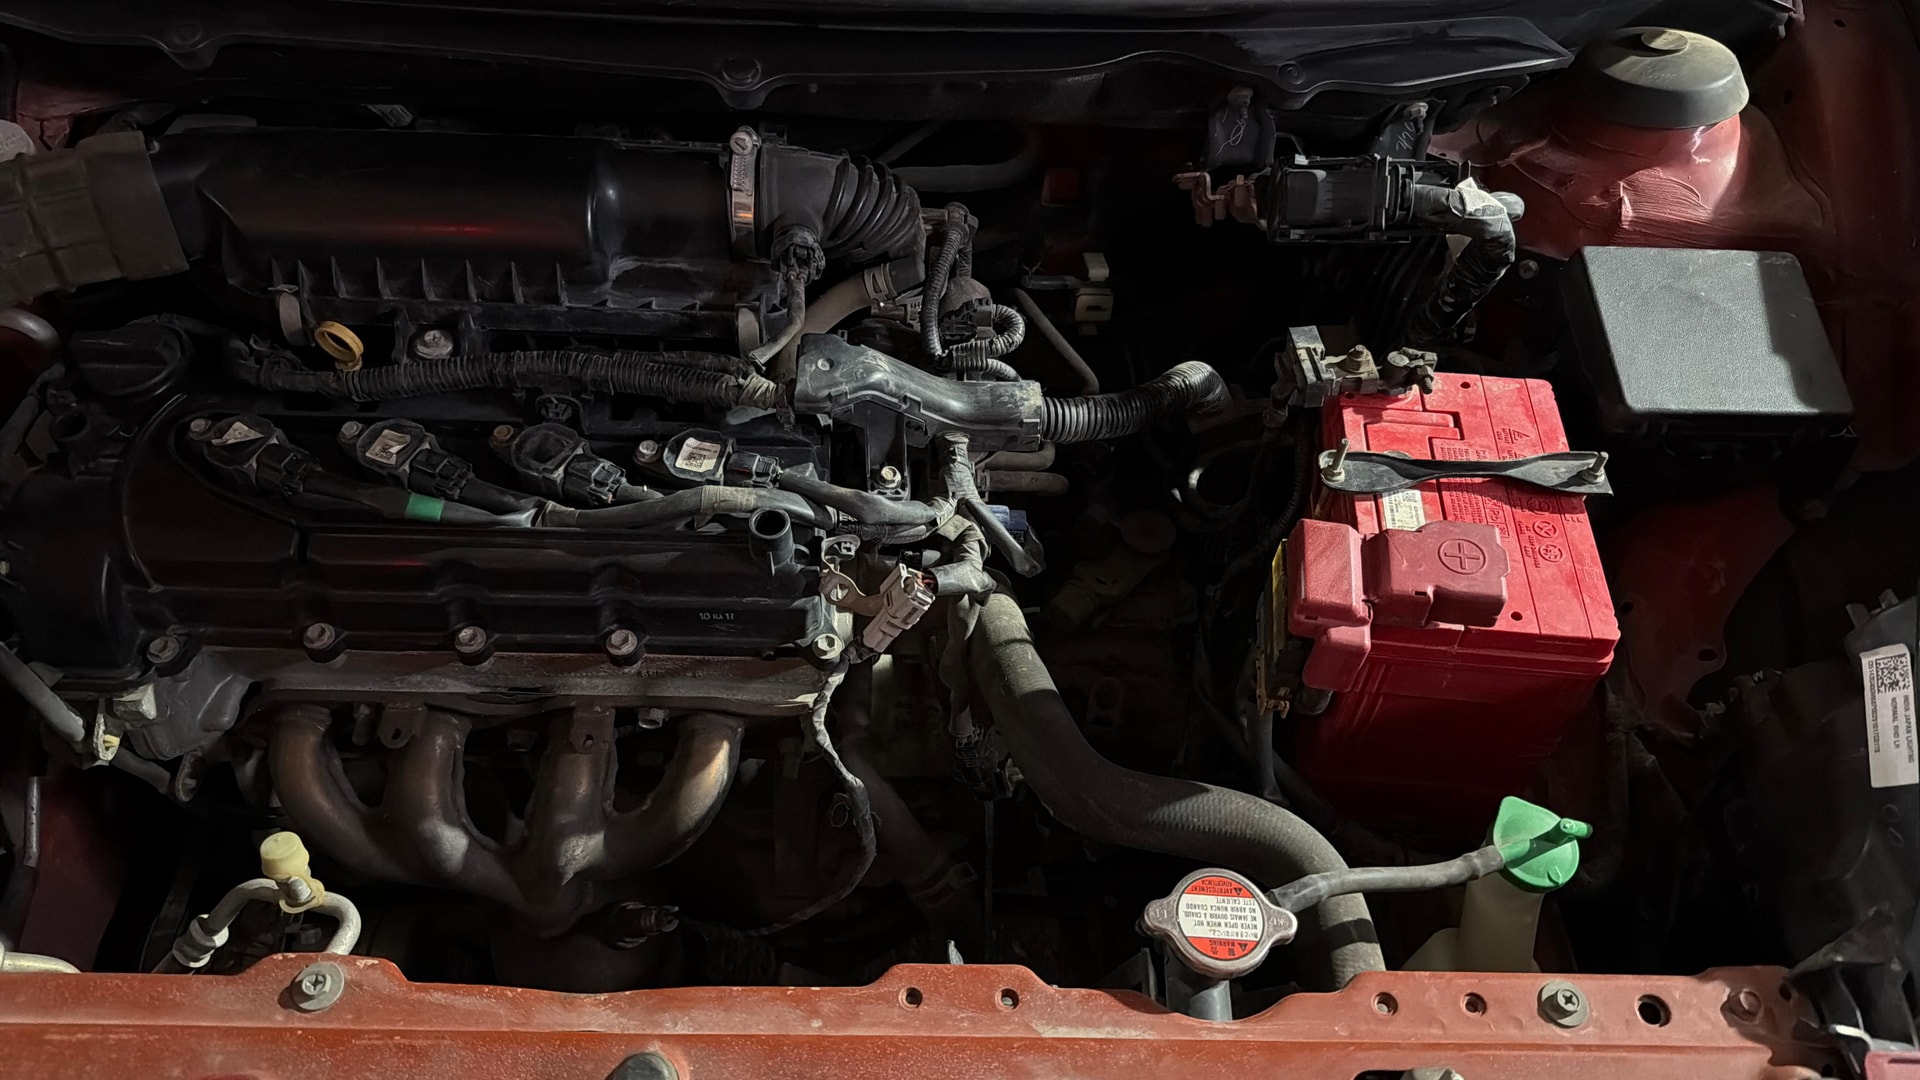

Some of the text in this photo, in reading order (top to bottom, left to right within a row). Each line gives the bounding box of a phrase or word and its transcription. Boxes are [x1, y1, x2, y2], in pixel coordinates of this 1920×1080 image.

[1904, 714, 1912, 734] JAPAN
[1894, 740, 1900, 748] LH
[1190, 886, 1233, 894] AVERTISSEMENT
[1186, 903, 1208, 911] CUANDO
[1182, 910, 1202, 918] CHAUD.
[1203, 912, 1207, 920] À
